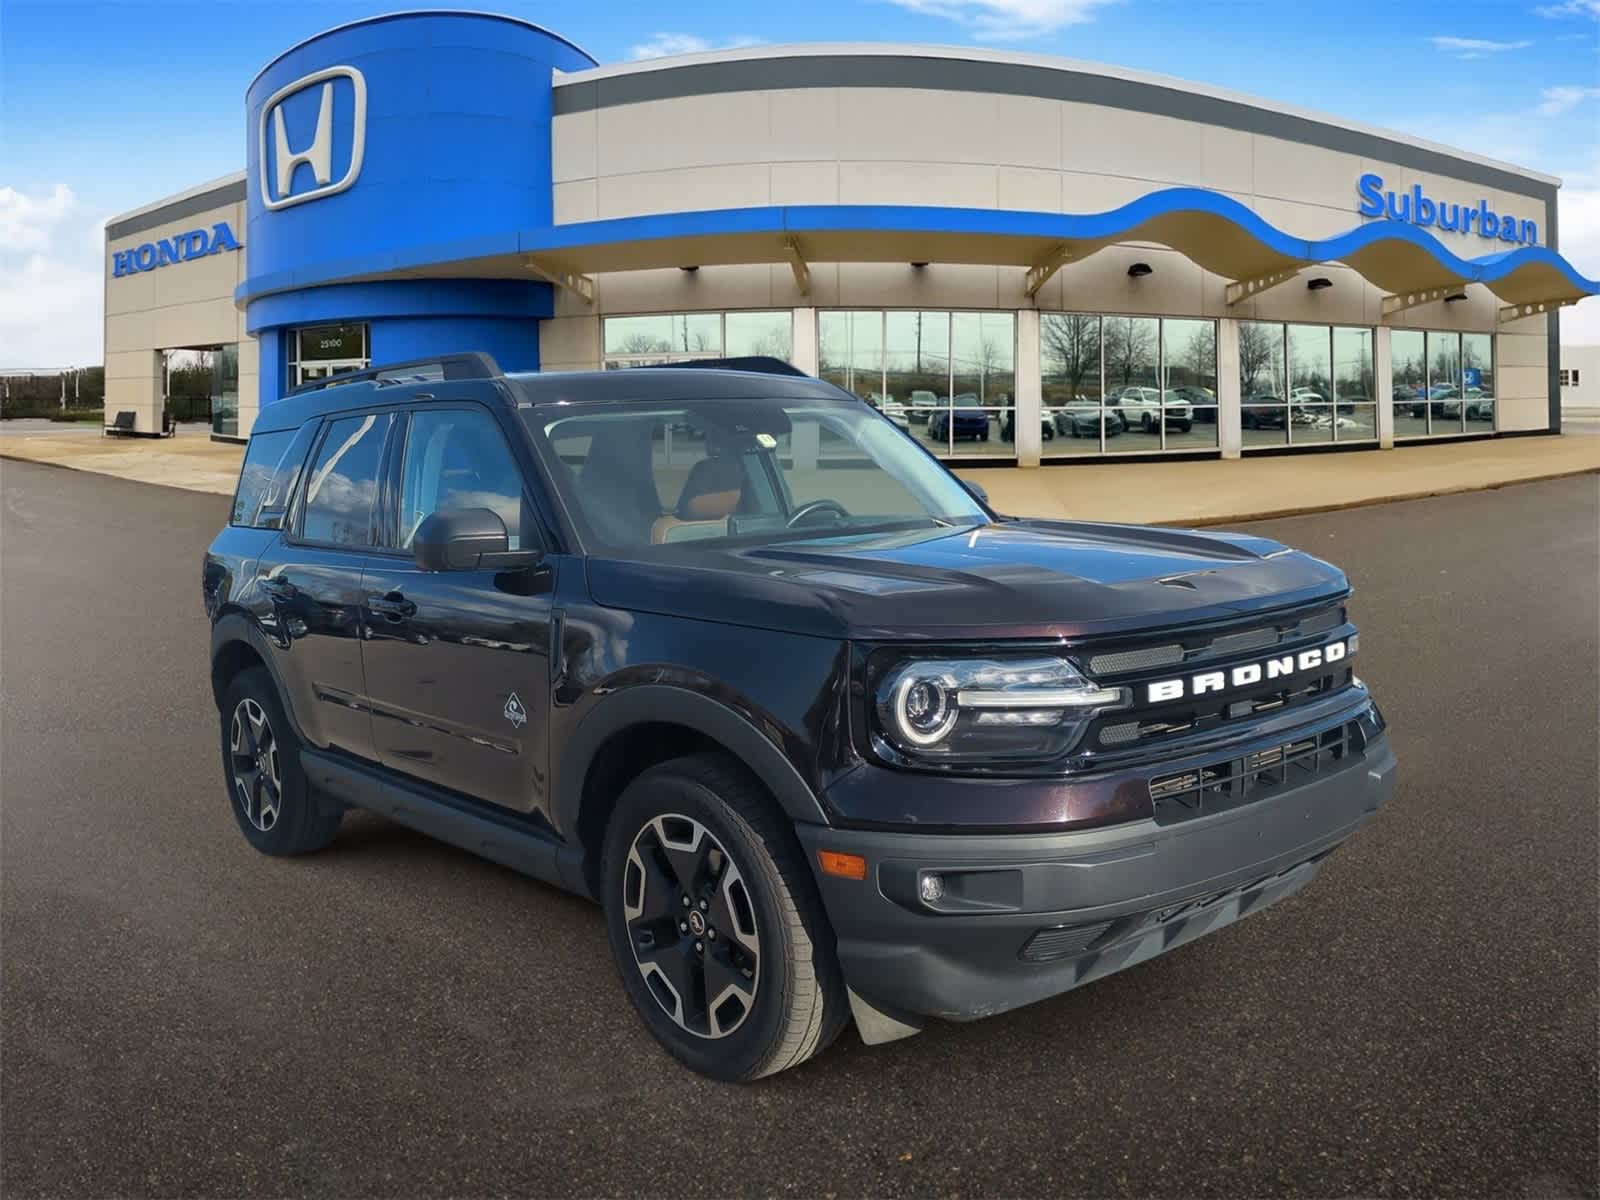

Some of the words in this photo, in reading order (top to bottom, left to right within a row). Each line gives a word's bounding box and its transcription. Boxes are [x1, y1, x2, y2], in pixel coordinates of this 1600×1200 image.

[1358, 173, 1538, 244] Suburban
[112, 221, 241, 278] HONDA
[1148, 641, 1346, 703] BRONCO
